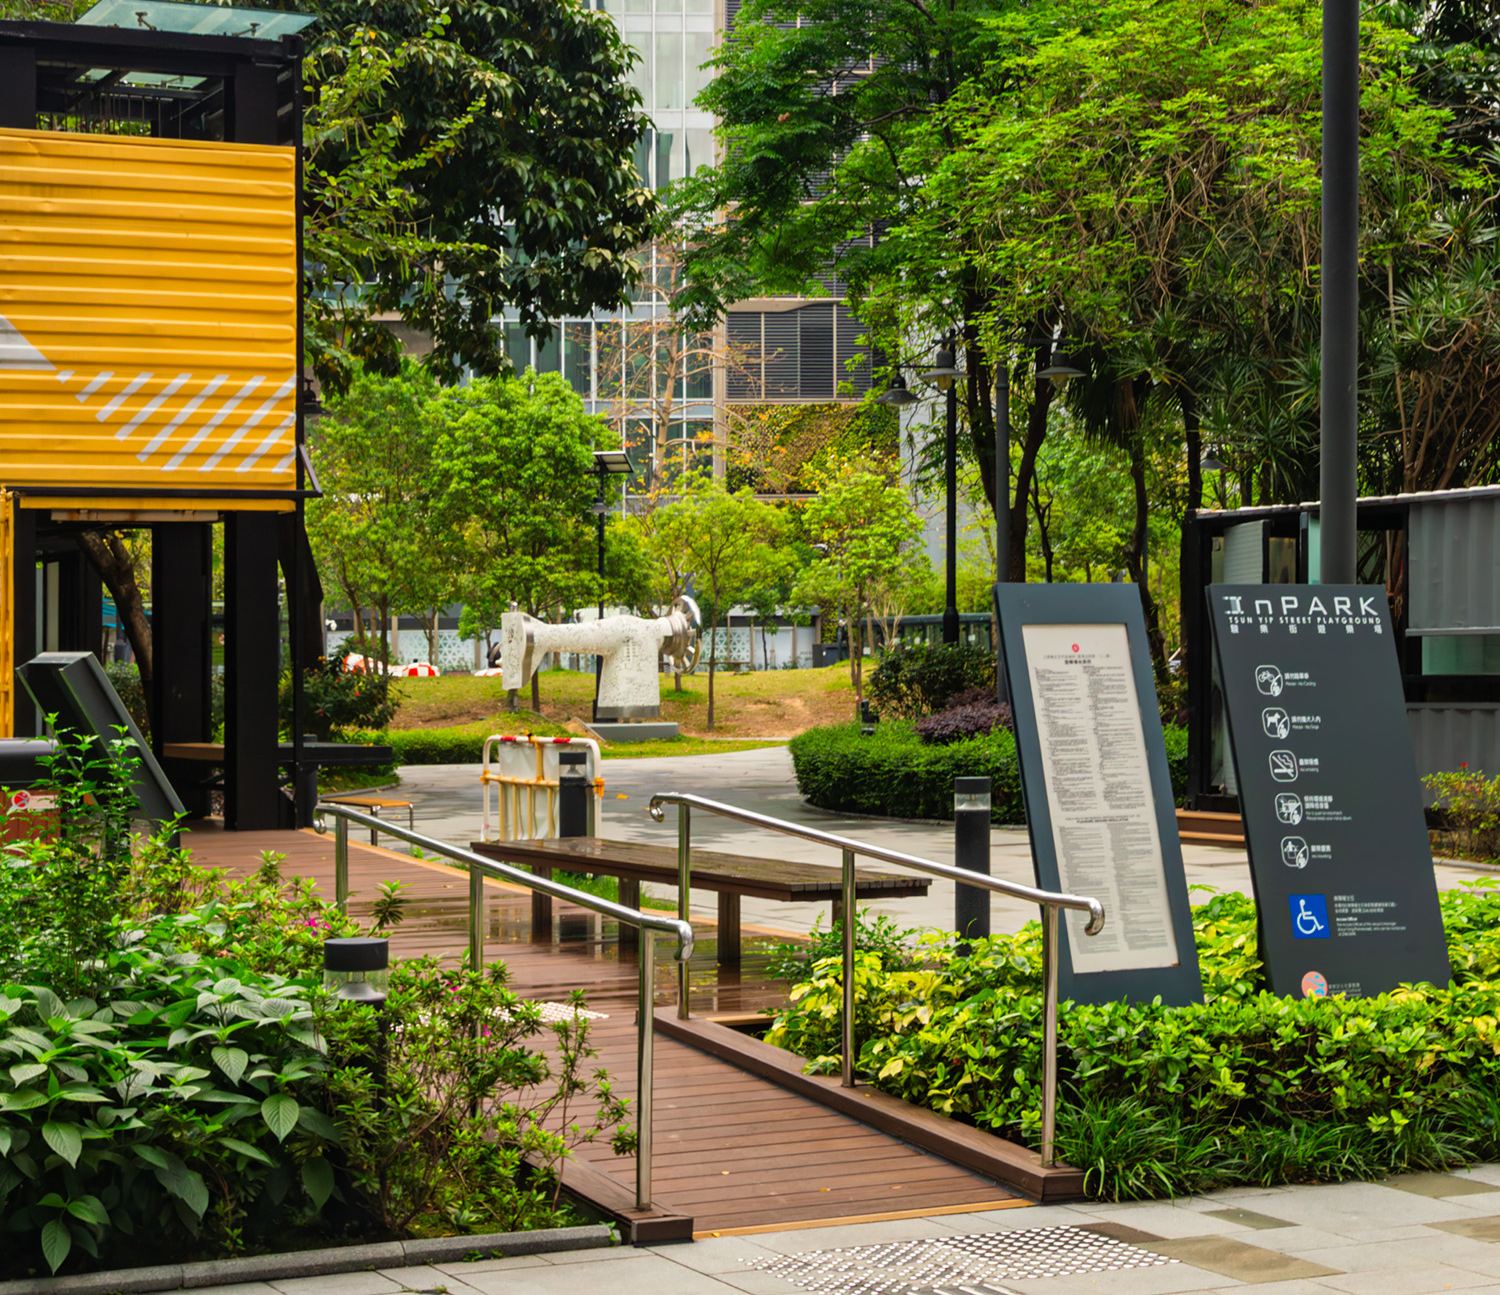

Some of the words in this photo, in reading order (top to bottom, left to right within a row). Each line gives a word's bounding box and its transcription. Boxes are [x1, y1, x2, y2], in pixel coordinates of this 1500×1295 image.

[1228, 616, 1253, 624] TSUN
[1258, 616, 1274, 624] YIP
[1279, 616, 1312, 624] STREET
[1316, 616, 1382, 624] PLAYGROUND
